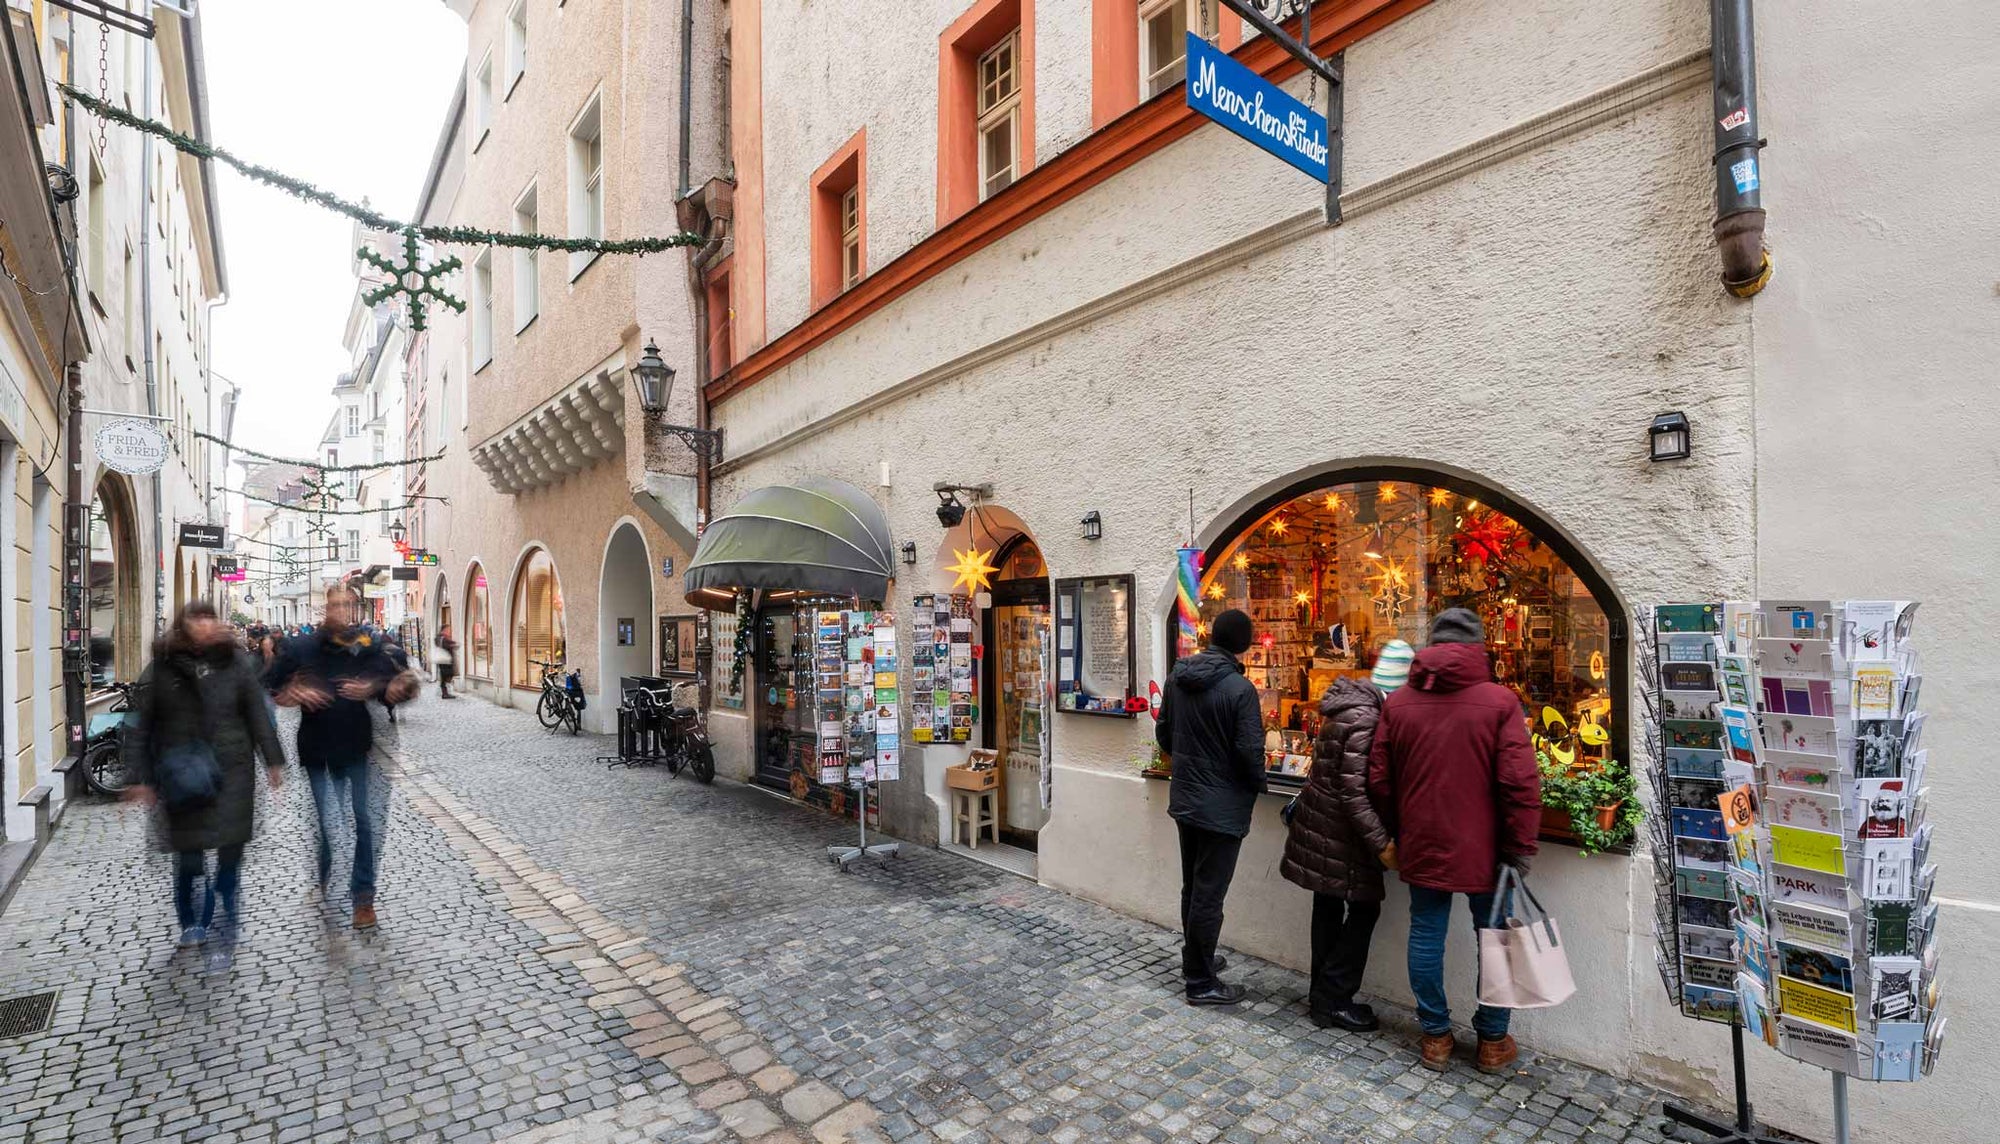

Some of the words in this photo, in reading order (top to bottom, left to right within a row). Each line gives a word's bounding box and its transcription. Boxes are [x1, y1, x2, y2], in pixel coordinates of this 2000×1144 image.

[108, 434, 147, 447] FRIDA
[114, 446, 123, 455] &
[126, 447, 160, 457] FRED
